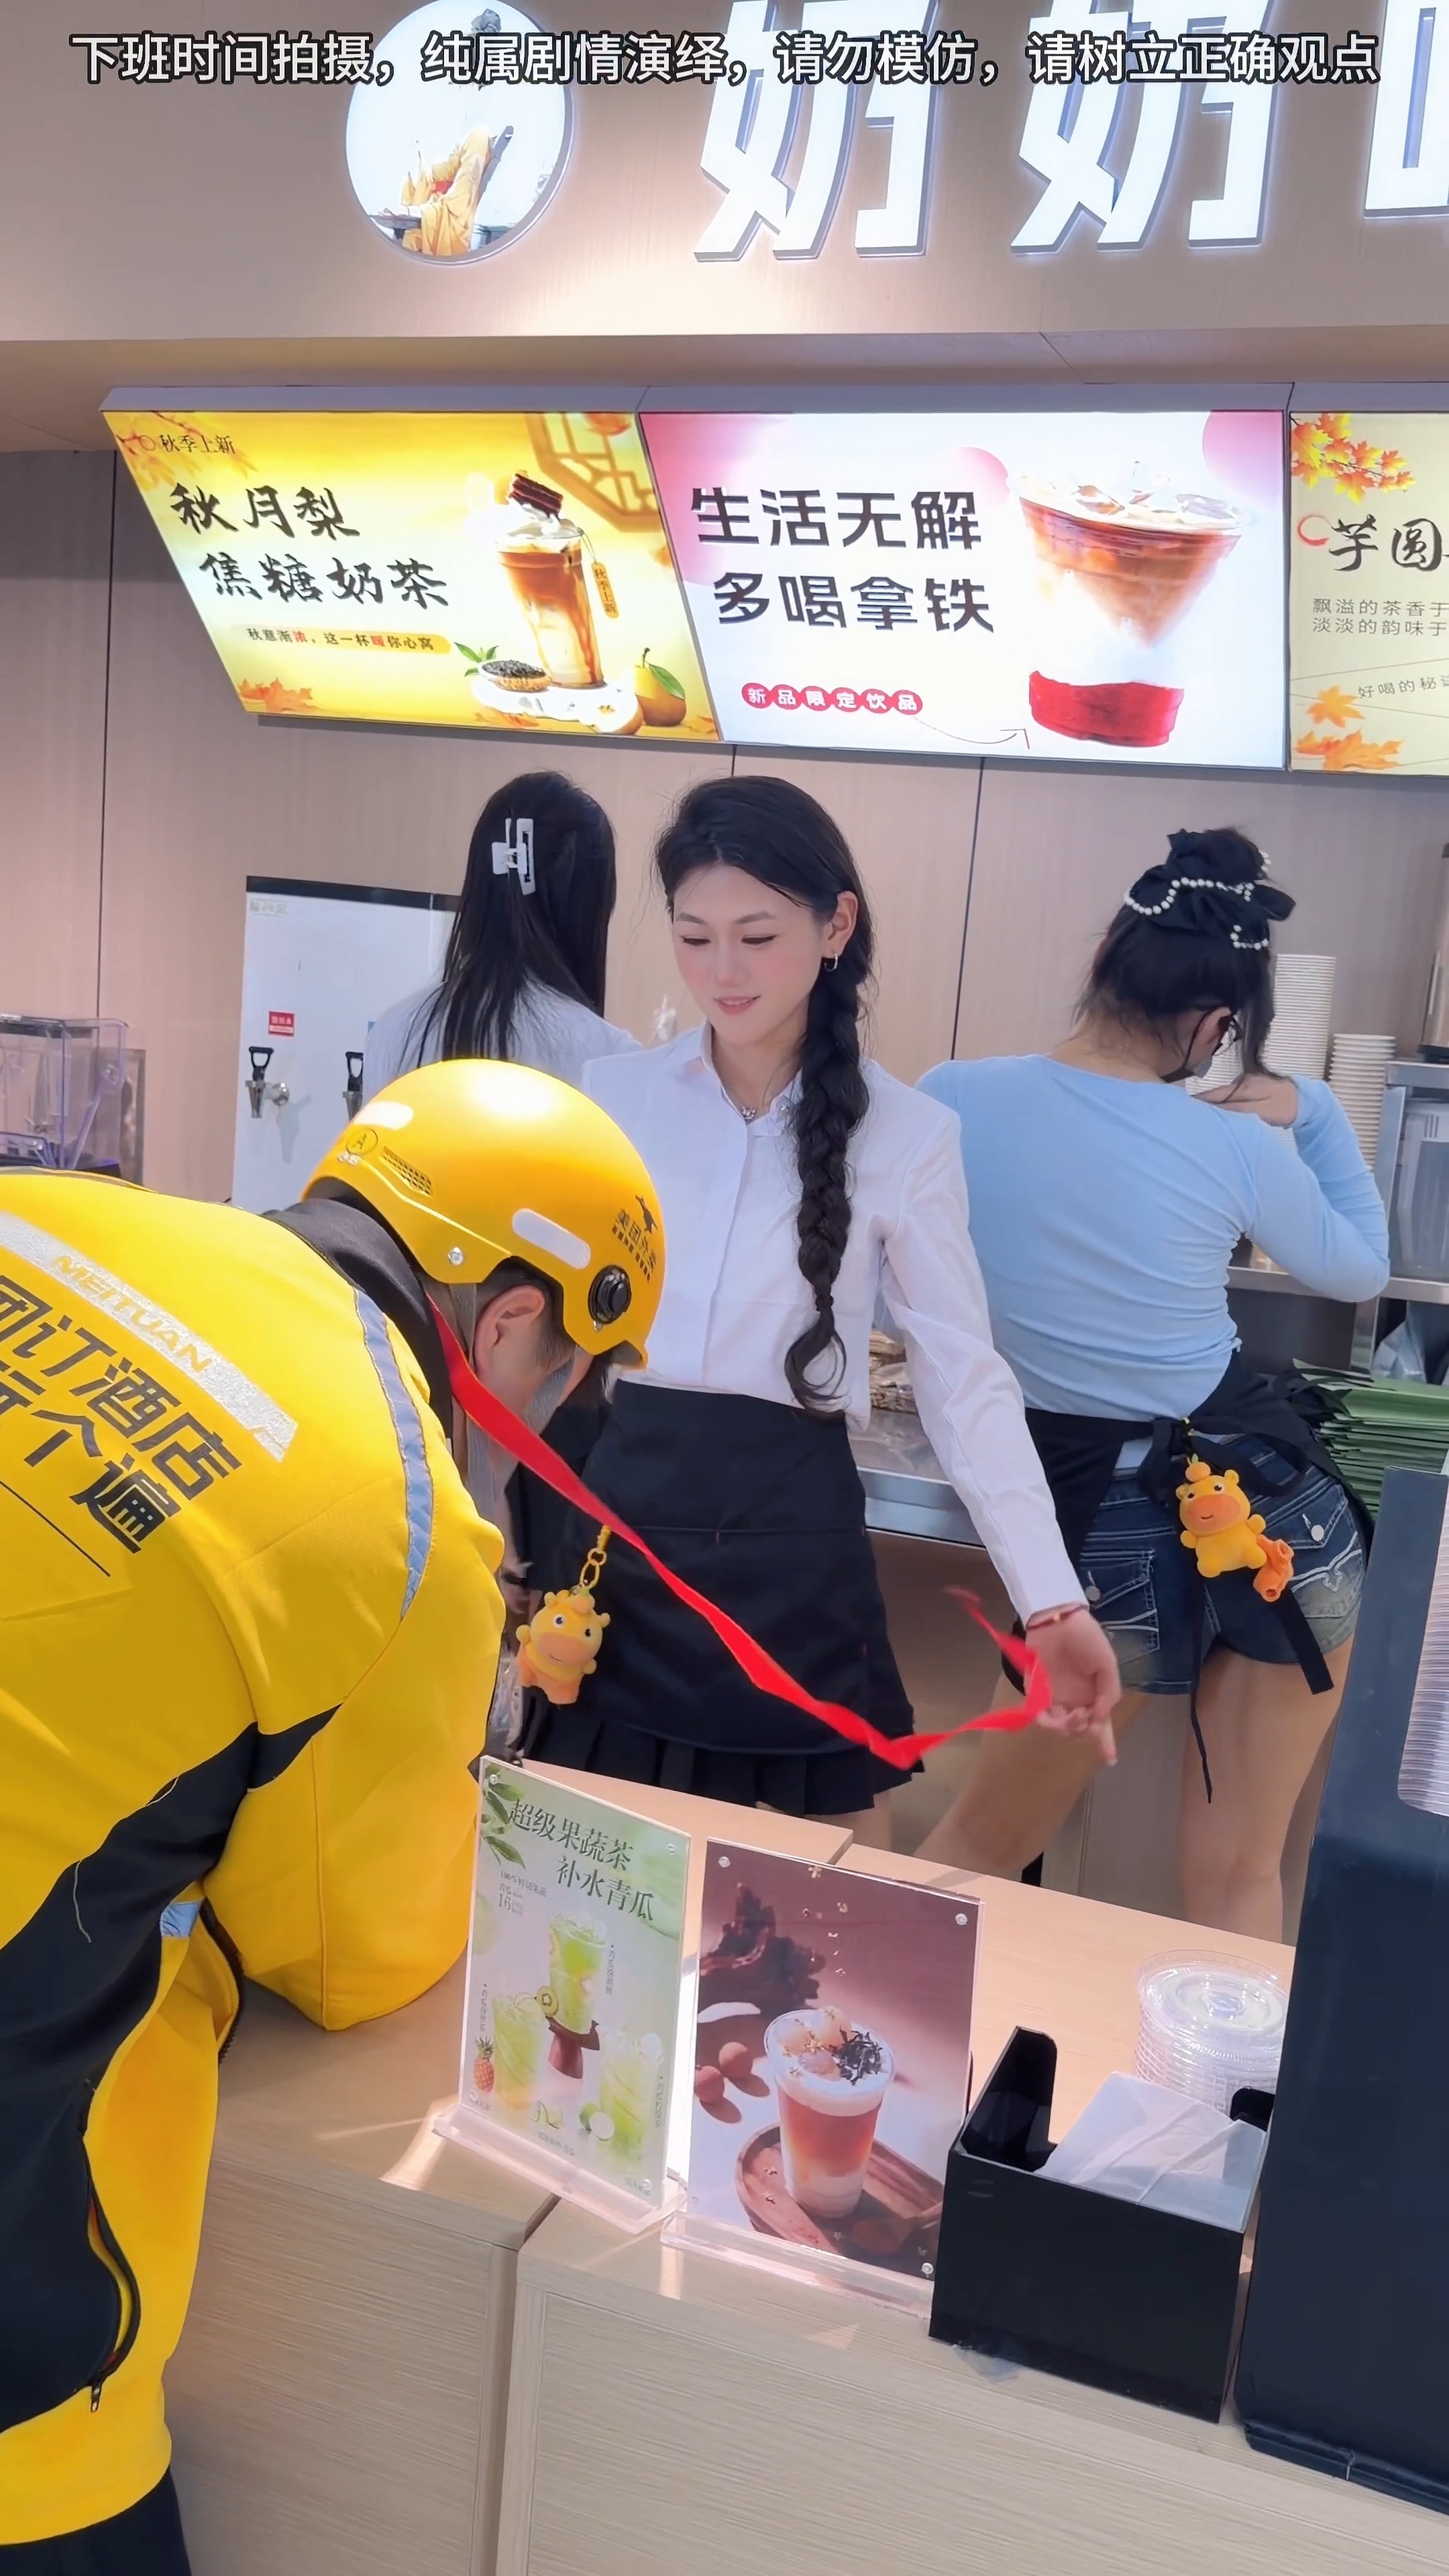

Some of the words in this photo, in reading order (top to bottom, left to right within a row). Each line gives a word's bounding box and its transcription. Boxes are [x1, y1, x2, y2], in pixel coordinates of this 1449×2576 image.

[694, 0, 1449, 263] 奶奶
[161, 434, 236, 455] 秋季上新
[170, 482, 360, 540] 秋月梨
[691, 486, 982, 550] 生活无解
[1329, 514, 1449, 572] 芋圆
[199, 552, 449, 609] 焦糖奶茶
[713, 572, 994, 633] 多喝拿铁
[1313, 598, 1449, 617] 飘溢的茶香于
[1312, 617, 1447, 637] 淡淡的韵味于
[747, 687, 918, 712] 新品限定饮品
[51, 1254, 213, 1373] MEITUAN
[508, 1798, 634, 1872] 超级果蔬茶
[556, 1856, 654, 1922] 补水青瓜
